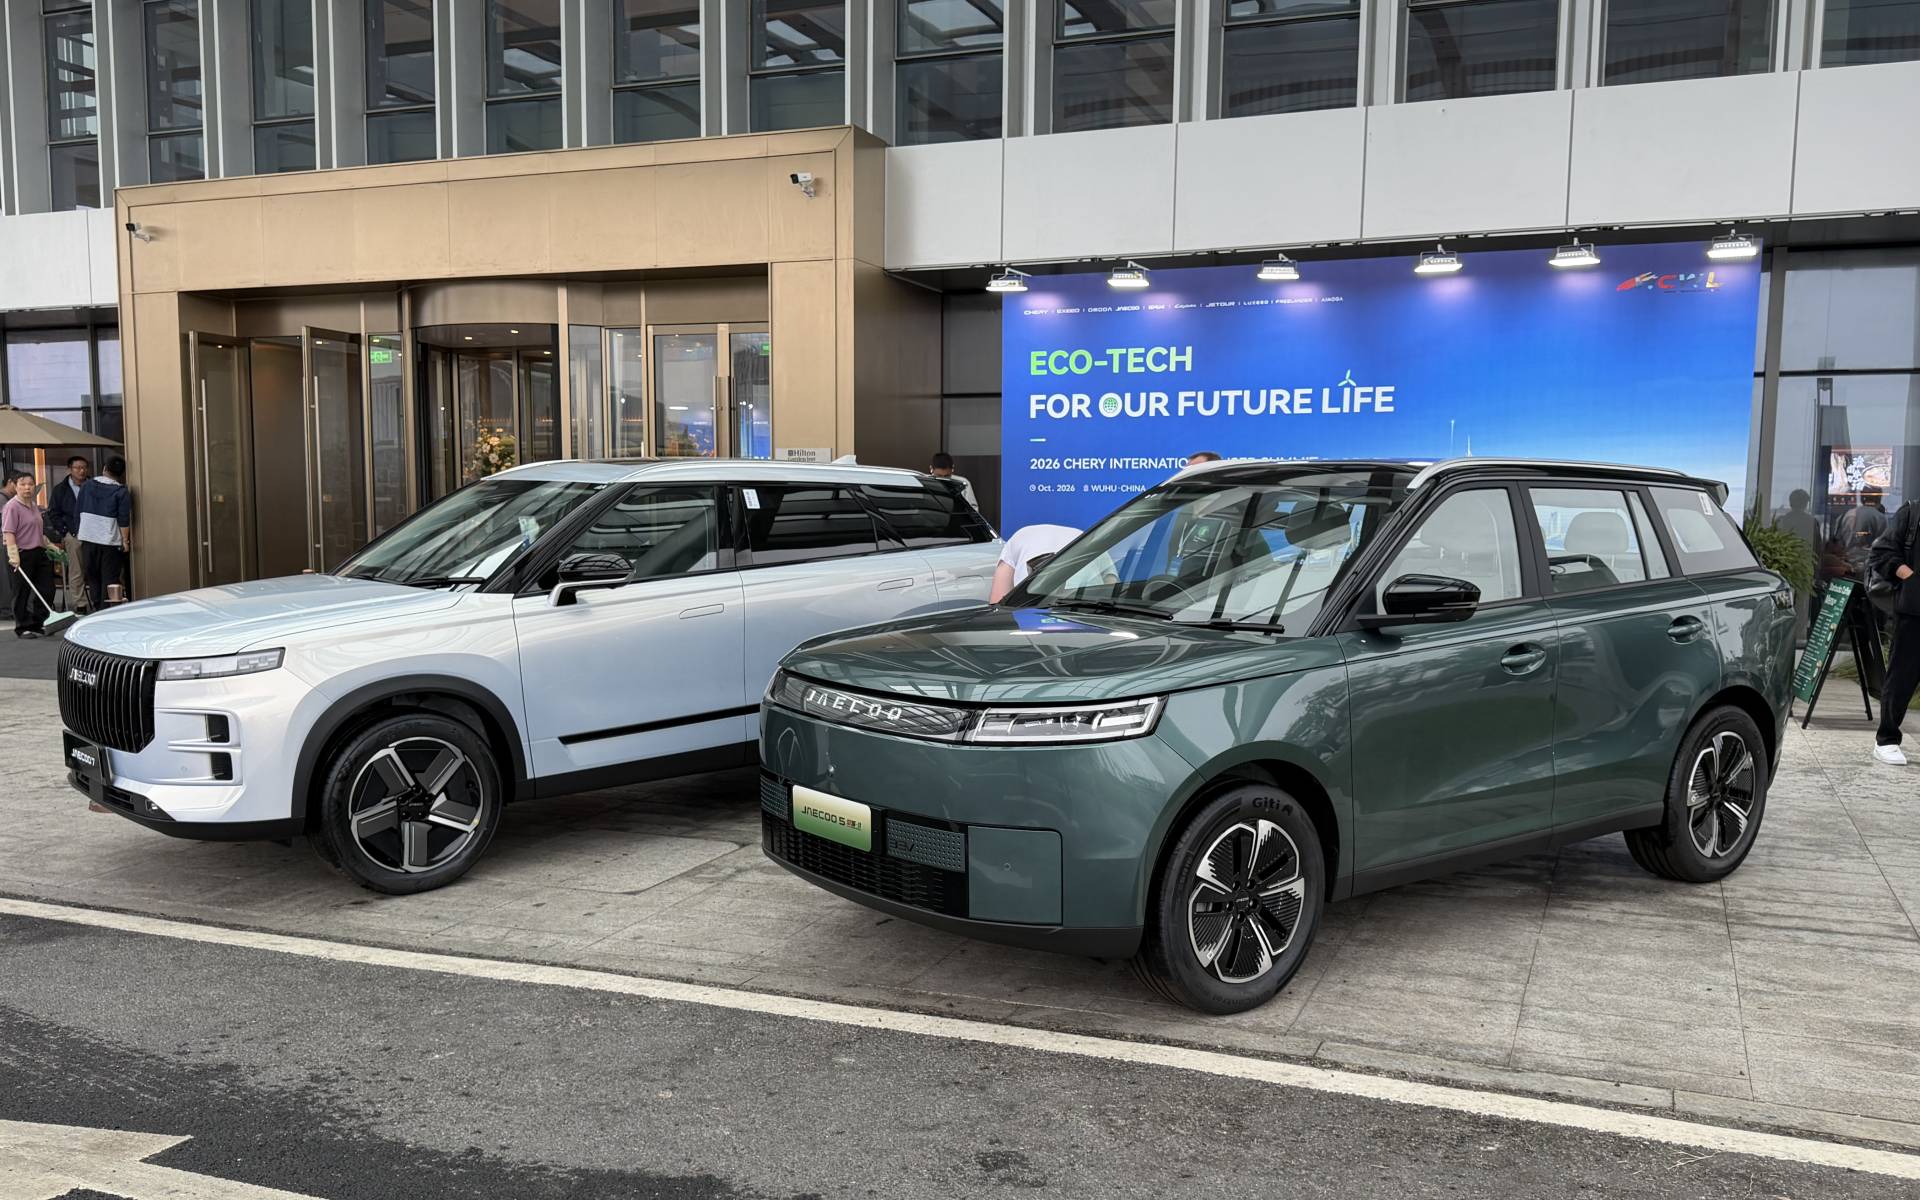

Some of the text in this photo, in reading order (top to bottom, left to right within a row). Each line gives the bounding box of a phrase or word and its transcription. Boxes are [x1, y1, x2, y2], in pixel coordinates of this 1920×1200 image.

[1030, 345, 1193, 375] ECO-TECH
[1029, 385, 1396, 419] FOR OUR FUTURE LIFE
[1030, 457, 1189, 470] 2026 CHERY INTERNATIO
[1037, 484, 1055, 492] Oct.
[1056, 484, 1076, 492] 2026
[806, 690, 902, 720] JAECOO
[1252, 796, 1281, 810] Giti
